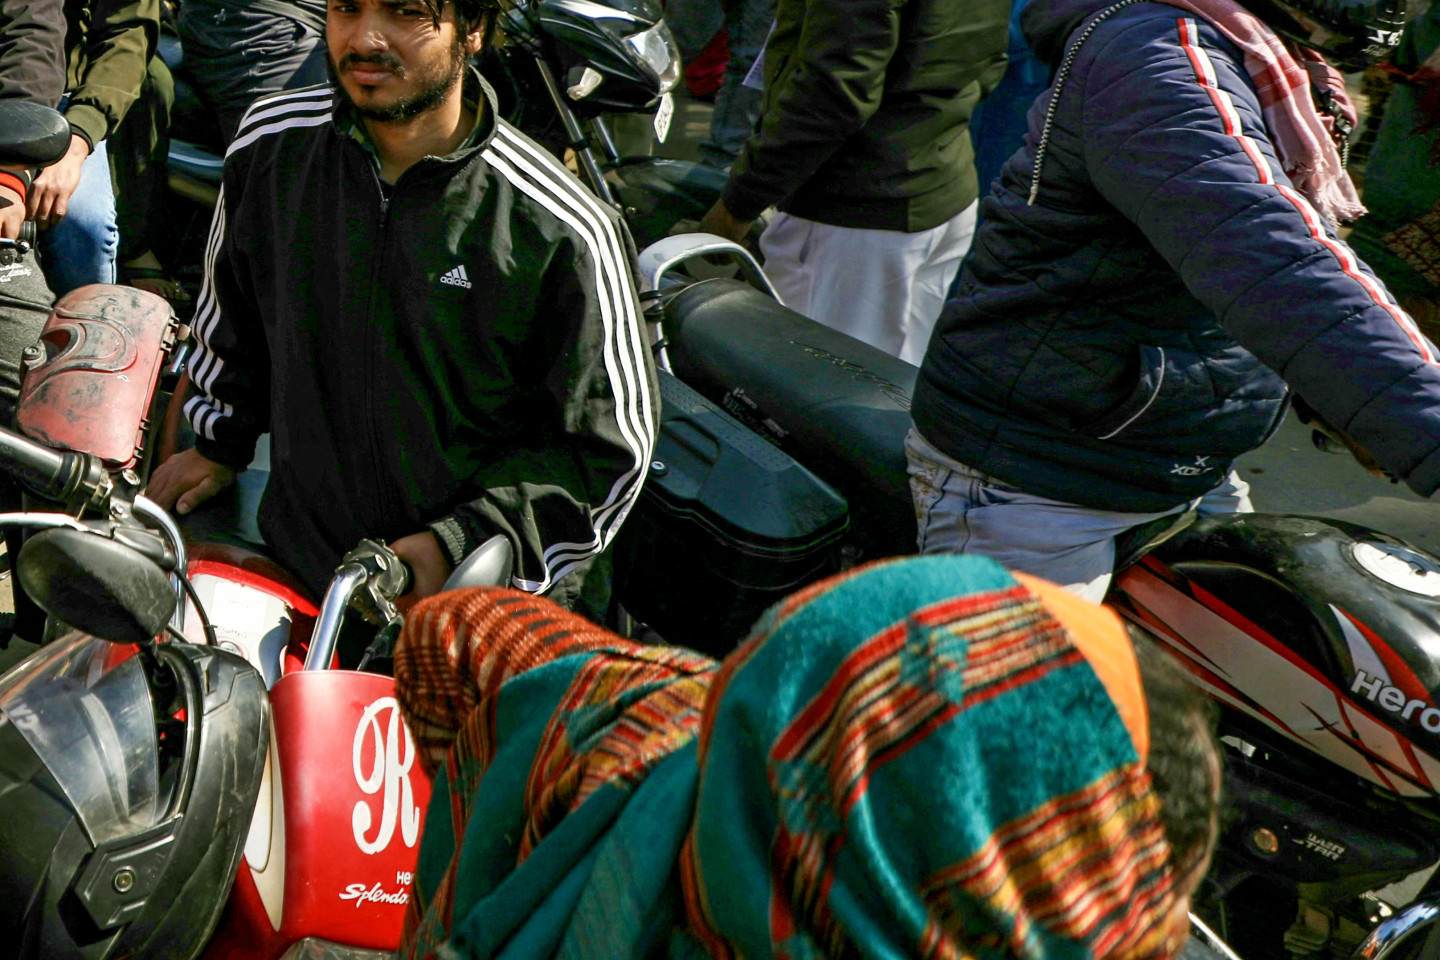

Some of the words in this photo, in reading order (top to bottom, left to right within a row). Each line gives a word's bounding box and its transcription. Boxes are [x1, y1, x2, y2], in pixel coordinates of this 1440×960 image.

[440, 276, 472, 288] adidas
[1350, 670, 1440, 733] Hero
[339, 882, 409, 908] Splendo
